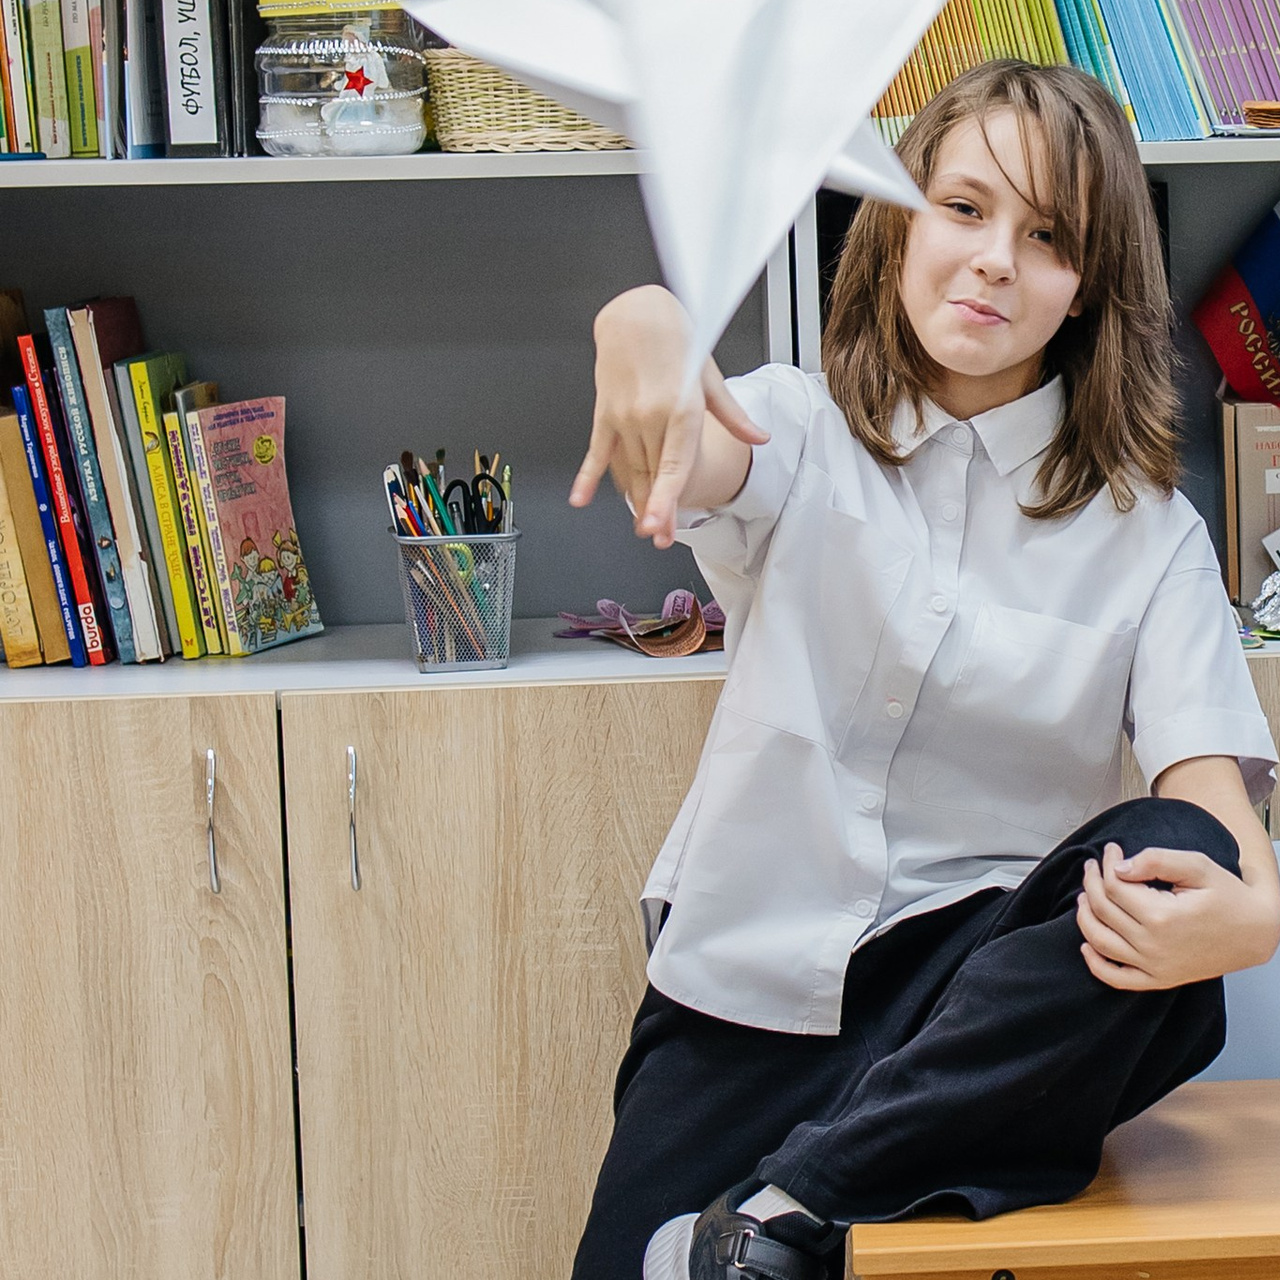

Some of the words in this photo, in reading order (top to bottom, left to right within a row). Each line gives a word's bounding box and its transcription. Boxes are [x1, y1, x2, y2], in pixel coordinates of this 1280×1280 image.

[179, 32, 203, 115] ФУТБОЛ,
[58, 346, 77, 405] ЖИВОПИСИ
[45, 433, 53, 444] из
[71, 408, 88, 455] РУССКОЙ
[48, 445, 62, 475] узоры
[83, 460, 98, 503] АЗБУКА
[152, 465, 167, 501] АЛИСА
[168, 429, 197, 536] ПРАЗДНИКИ
[161, 511, 176, 549] СТРАНЕ
[168, 549, 183, 581] ЧУДЕС
[190, 545, 215, 629] ДЕТСКИЕ
[80, 606, 100, 652] burda
